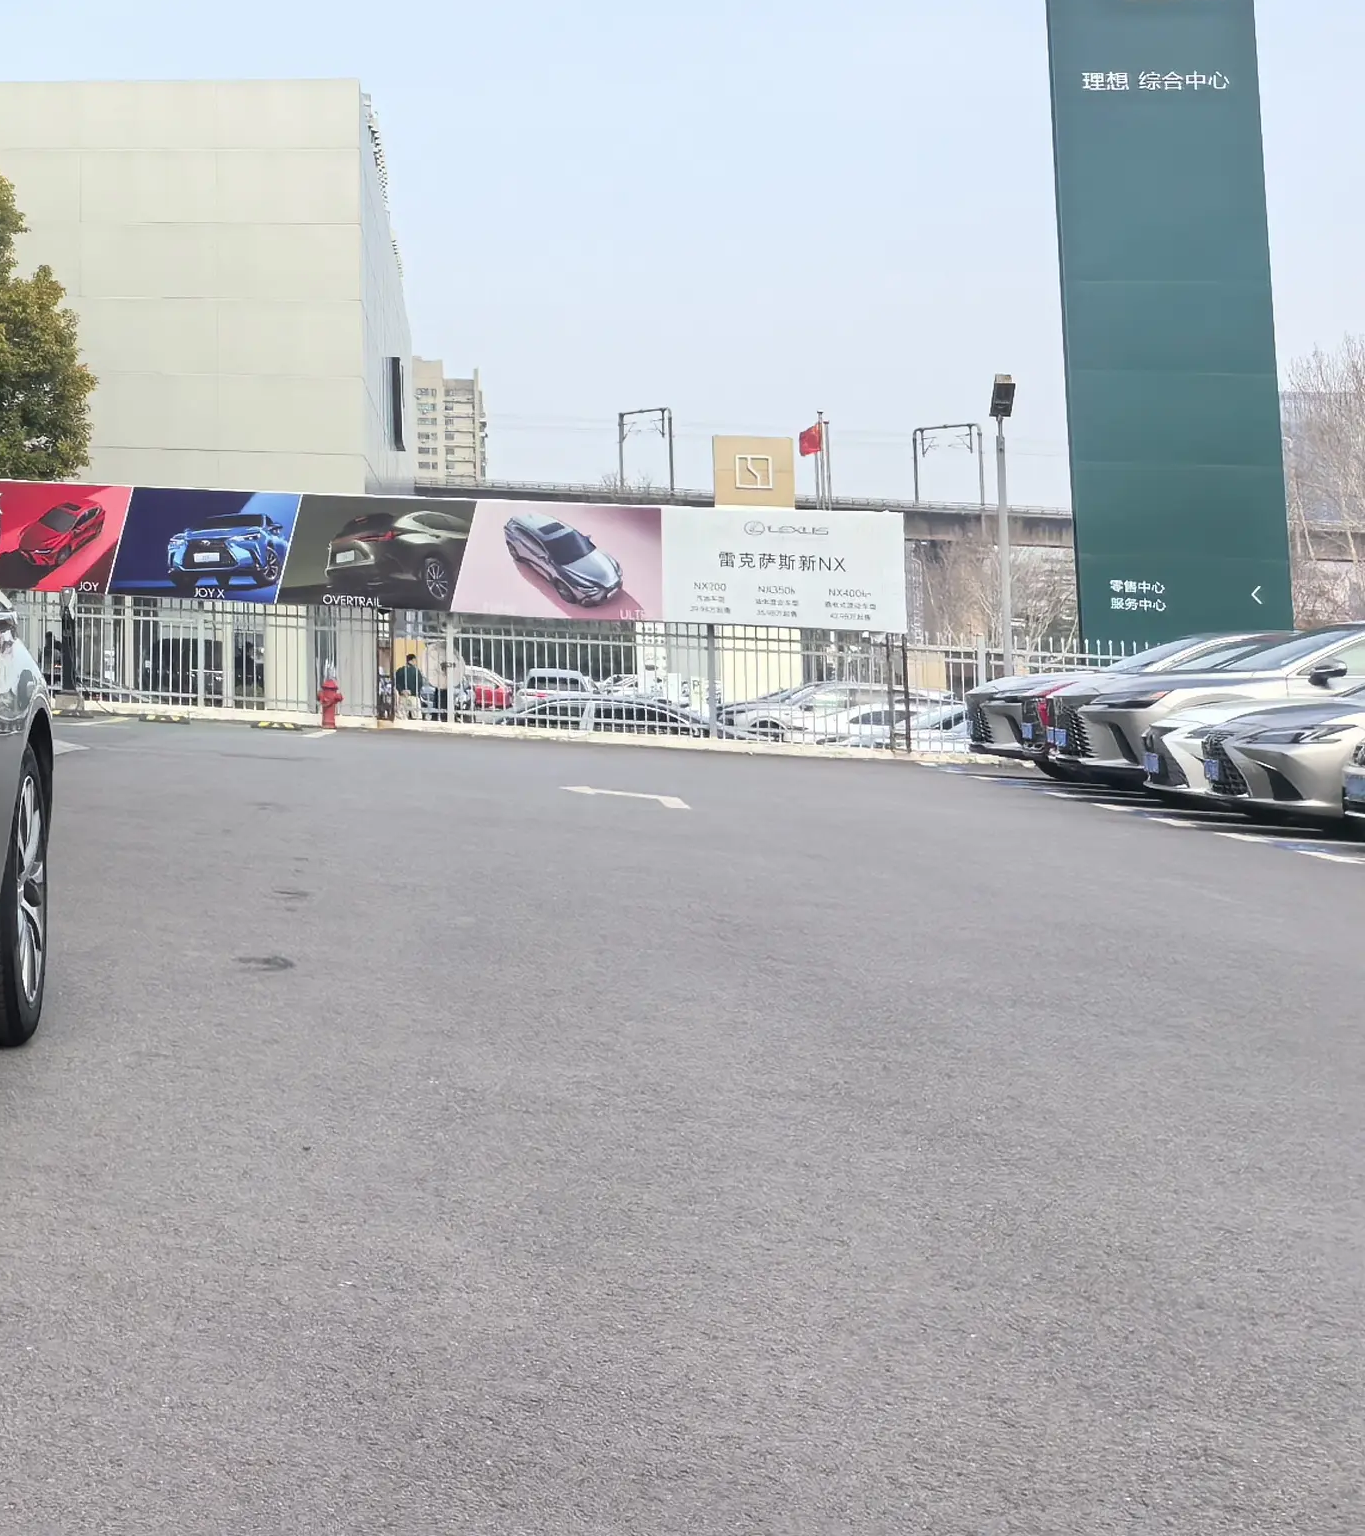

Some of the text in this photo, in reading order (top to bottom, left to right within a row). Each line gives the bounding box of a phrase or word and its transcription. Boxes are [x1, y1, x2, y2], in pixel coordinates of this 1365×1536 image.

[1081, 70, 1230, 91] 理想 综合中心
[767, 525, 829, 536] LEXUS
[718, 551, 846, 572] 雷克萨斯新NX
[78, 581, 100, 592] JOY
[193, 586, 225, 598] JOY X
[1109, 579, 1166, 594] 零售中心
[322, 594, 382, 608] OVERTRAIL
[1110, 597, 1167, 612] 服务中心
